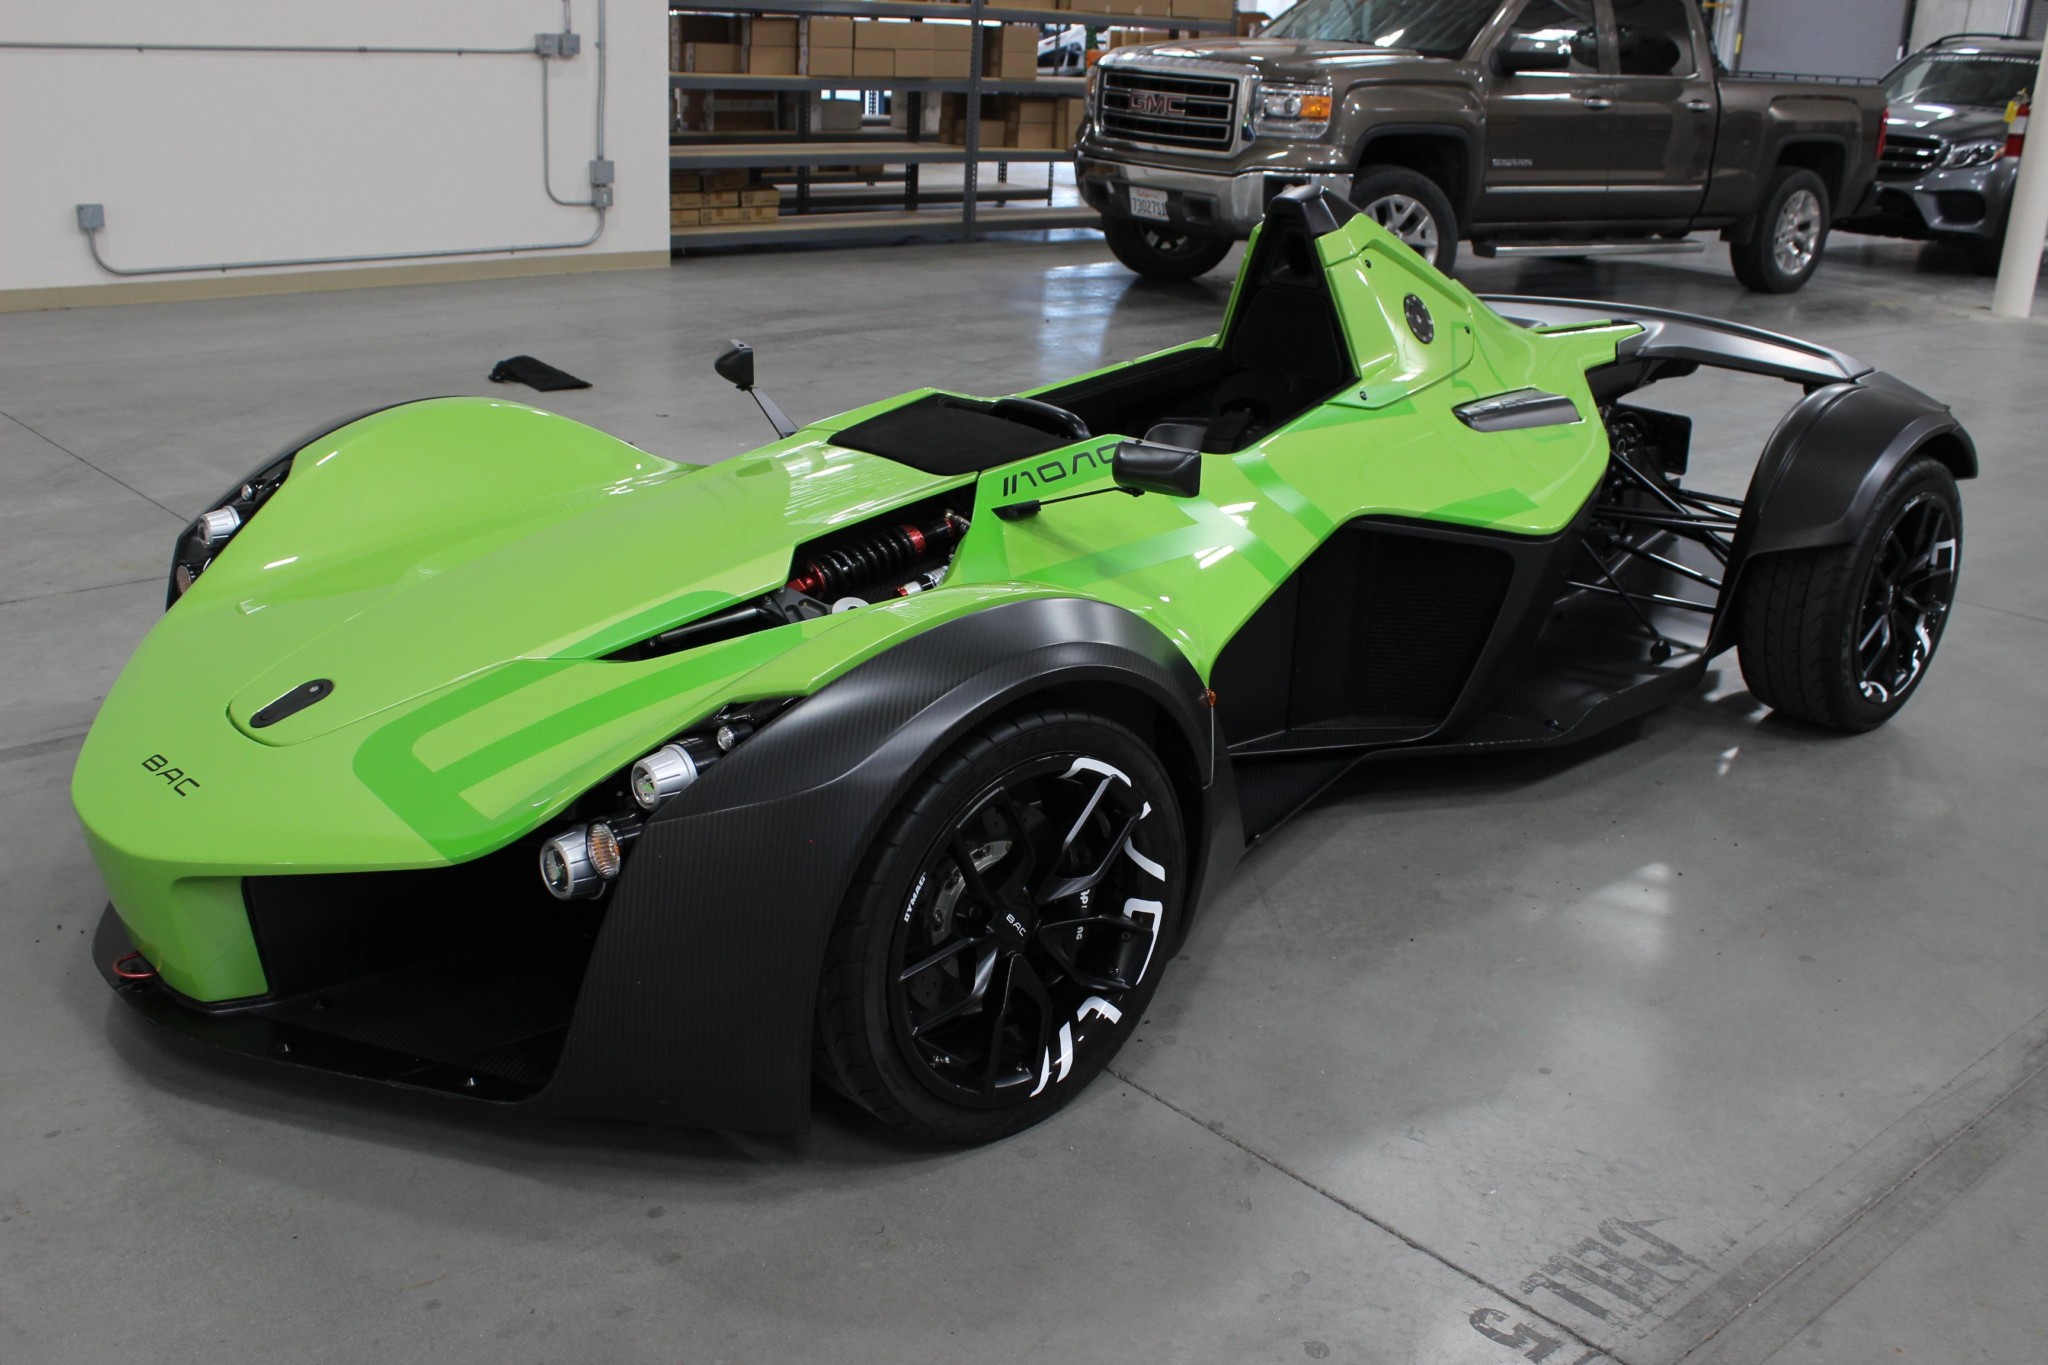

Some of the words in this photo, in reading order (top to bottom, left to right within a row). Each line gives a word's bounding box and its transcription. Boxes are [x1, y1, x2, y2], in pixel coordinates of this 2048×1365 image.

[1130, 91, 1186, 116] GMC
[141, 754, 200, 797] BAC
[1005, 913, 1027, 937] BAC
